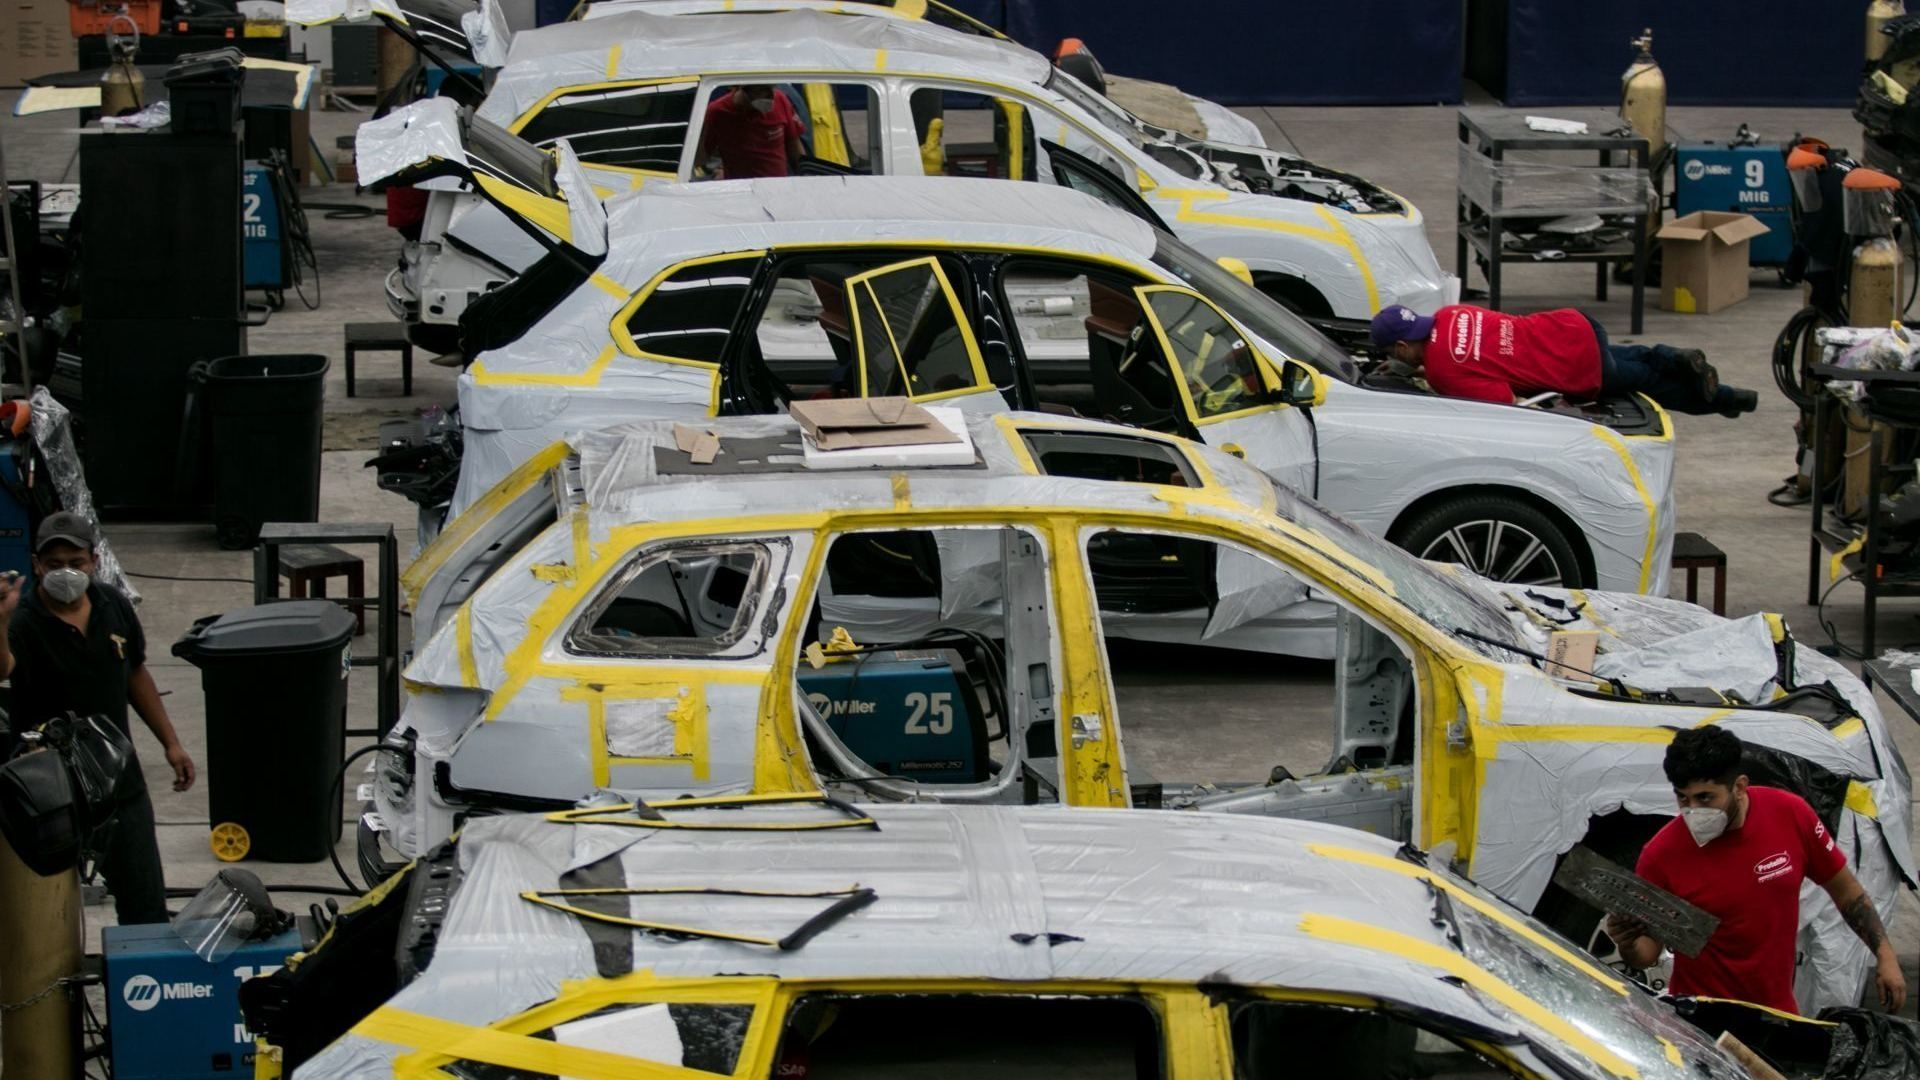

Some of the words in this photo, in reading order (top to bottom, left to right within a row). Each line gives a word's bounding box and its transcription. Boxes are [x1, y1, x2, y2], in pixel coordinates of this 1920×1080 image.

[1745, 160, 1764, 188] 9
[243, 193, 261, 222] 2
[1739, 191, 1769, 203] MIG
[834, 700, 876, 715] Miller
[904, 692, 953, 734] 25
[163, 982, 213, 1000] Miller
